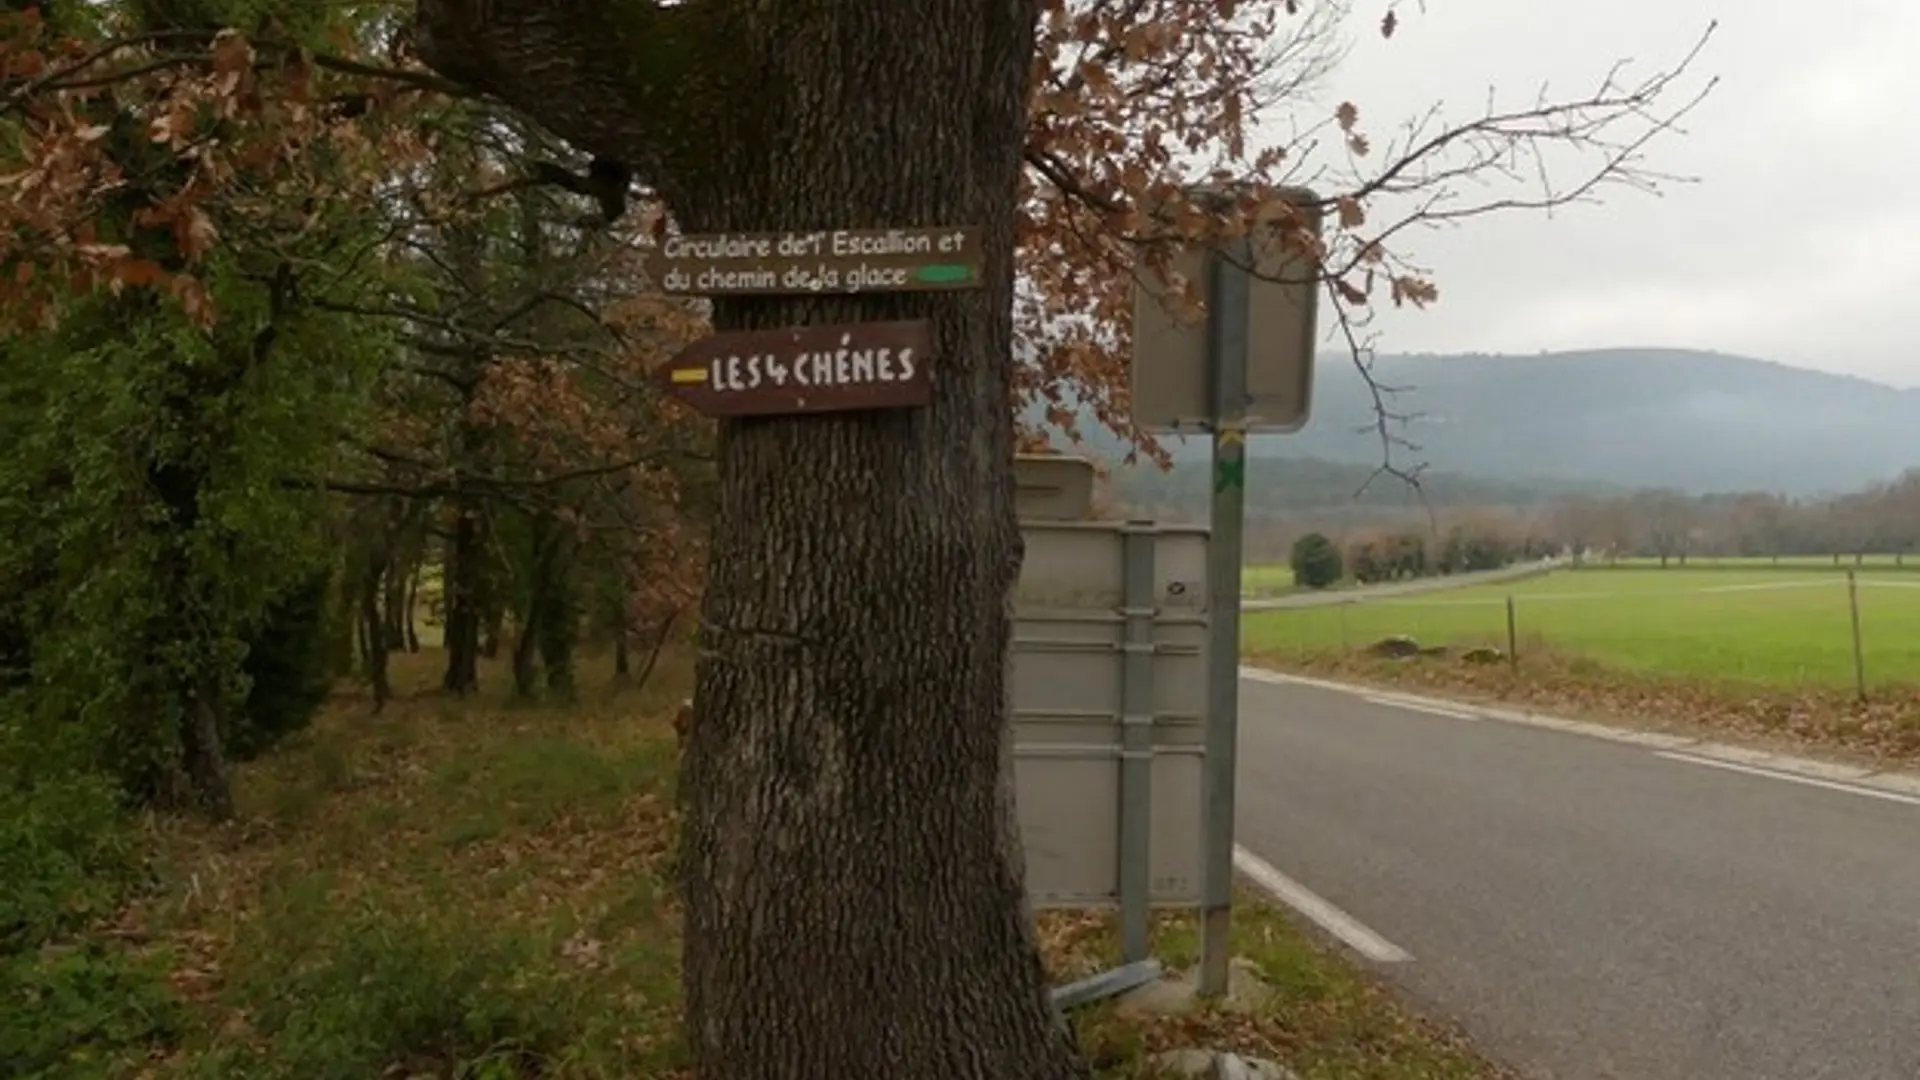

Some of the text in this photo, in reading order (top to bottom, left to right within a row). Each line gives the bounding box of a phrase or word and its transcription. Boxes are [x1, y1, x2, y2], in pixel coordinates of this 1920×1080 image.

[664, 234, 771, 258] Circulaire
[777, 232, 807, 256] de
[938, 231, 965, 253] et
[664, 262, 908, 293] du chemin de la glace
[711, 355, 761, 392] LES
[765, 353, 789, 386] 4
